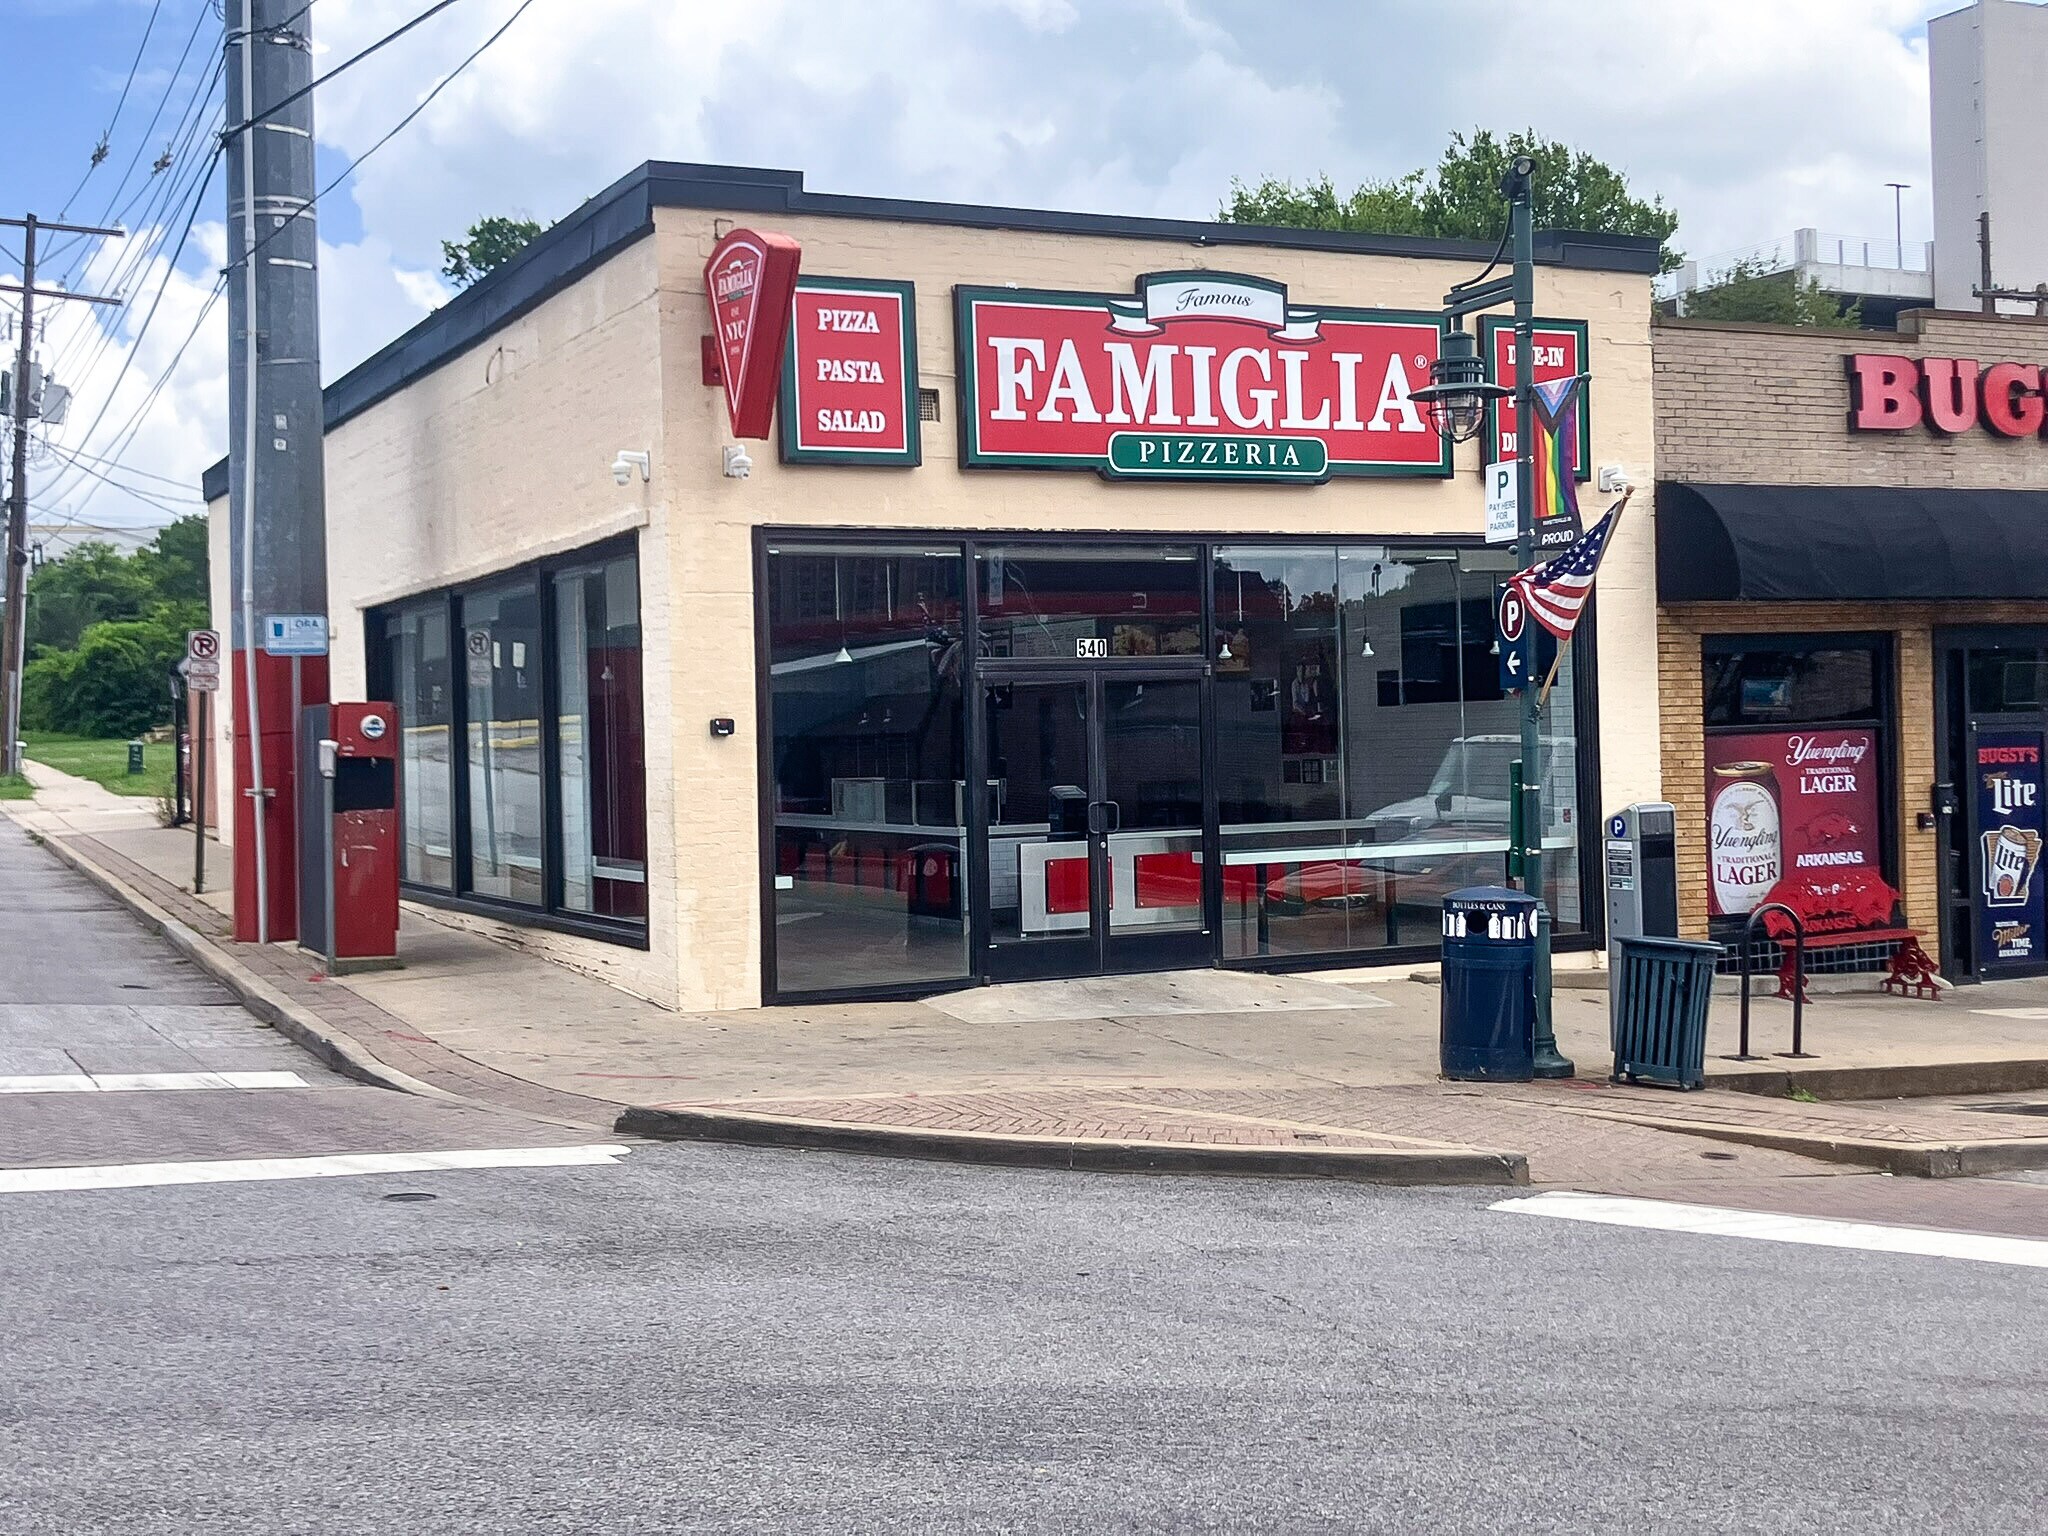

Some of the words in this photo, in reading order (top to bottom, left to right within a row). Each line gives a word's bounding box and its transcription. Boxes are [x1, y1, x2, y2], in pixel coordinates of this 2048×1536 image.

[1176, 288, 1254, 311] Famous
[726, 320, 747, 342] NYC
[817, 309, 880, 333] PIZZA
[1507, 344, 1565, 367] DE-IN
[817, 359, 884, 384] PASTA
[988, 336, 1426, 432] FAMIGLIA
[1850, 352, 2048, 438] BUG
[817, 409, 886, 433] SALAD
[1139, 441, 1300, 466] PIZZERIA
[1498, 471, 1508, 499] P
[1489, 503, 1501, 512] PAY
[1501, 500, 1516, 510] HERE
[1496, 512, 1508, 520] FOR
[1489, 520, 1515, 531] PARKING
[1541, 530, 1574, 545] PROUD
[1508, 600, 1519, 631] P
[1078, 639, 1106, 657] 540
[1786, 736, 1869, 766] Yuengling
[1800, 774, 1857, 794] LAGER
[1992, 778, 2036, 815] Lite
[1614, 819, 1623, 834] P
[1712, 823, 1778, 852] Yuengling
[1722, 853, 1773, 864] TRADITIONAL
[1796, 851, 1865, 868] ARKANSAS
[1995, 844, 2025, 870] Lite
[1717, 861, 1778, 886] LAGER
[1452, 901, 1479, 910] BOTTLES
[1480, 902, 1486, 910] &
[1486, 902, 1506, 911] CANS
[1992, 923, 2031, 949] Miller
